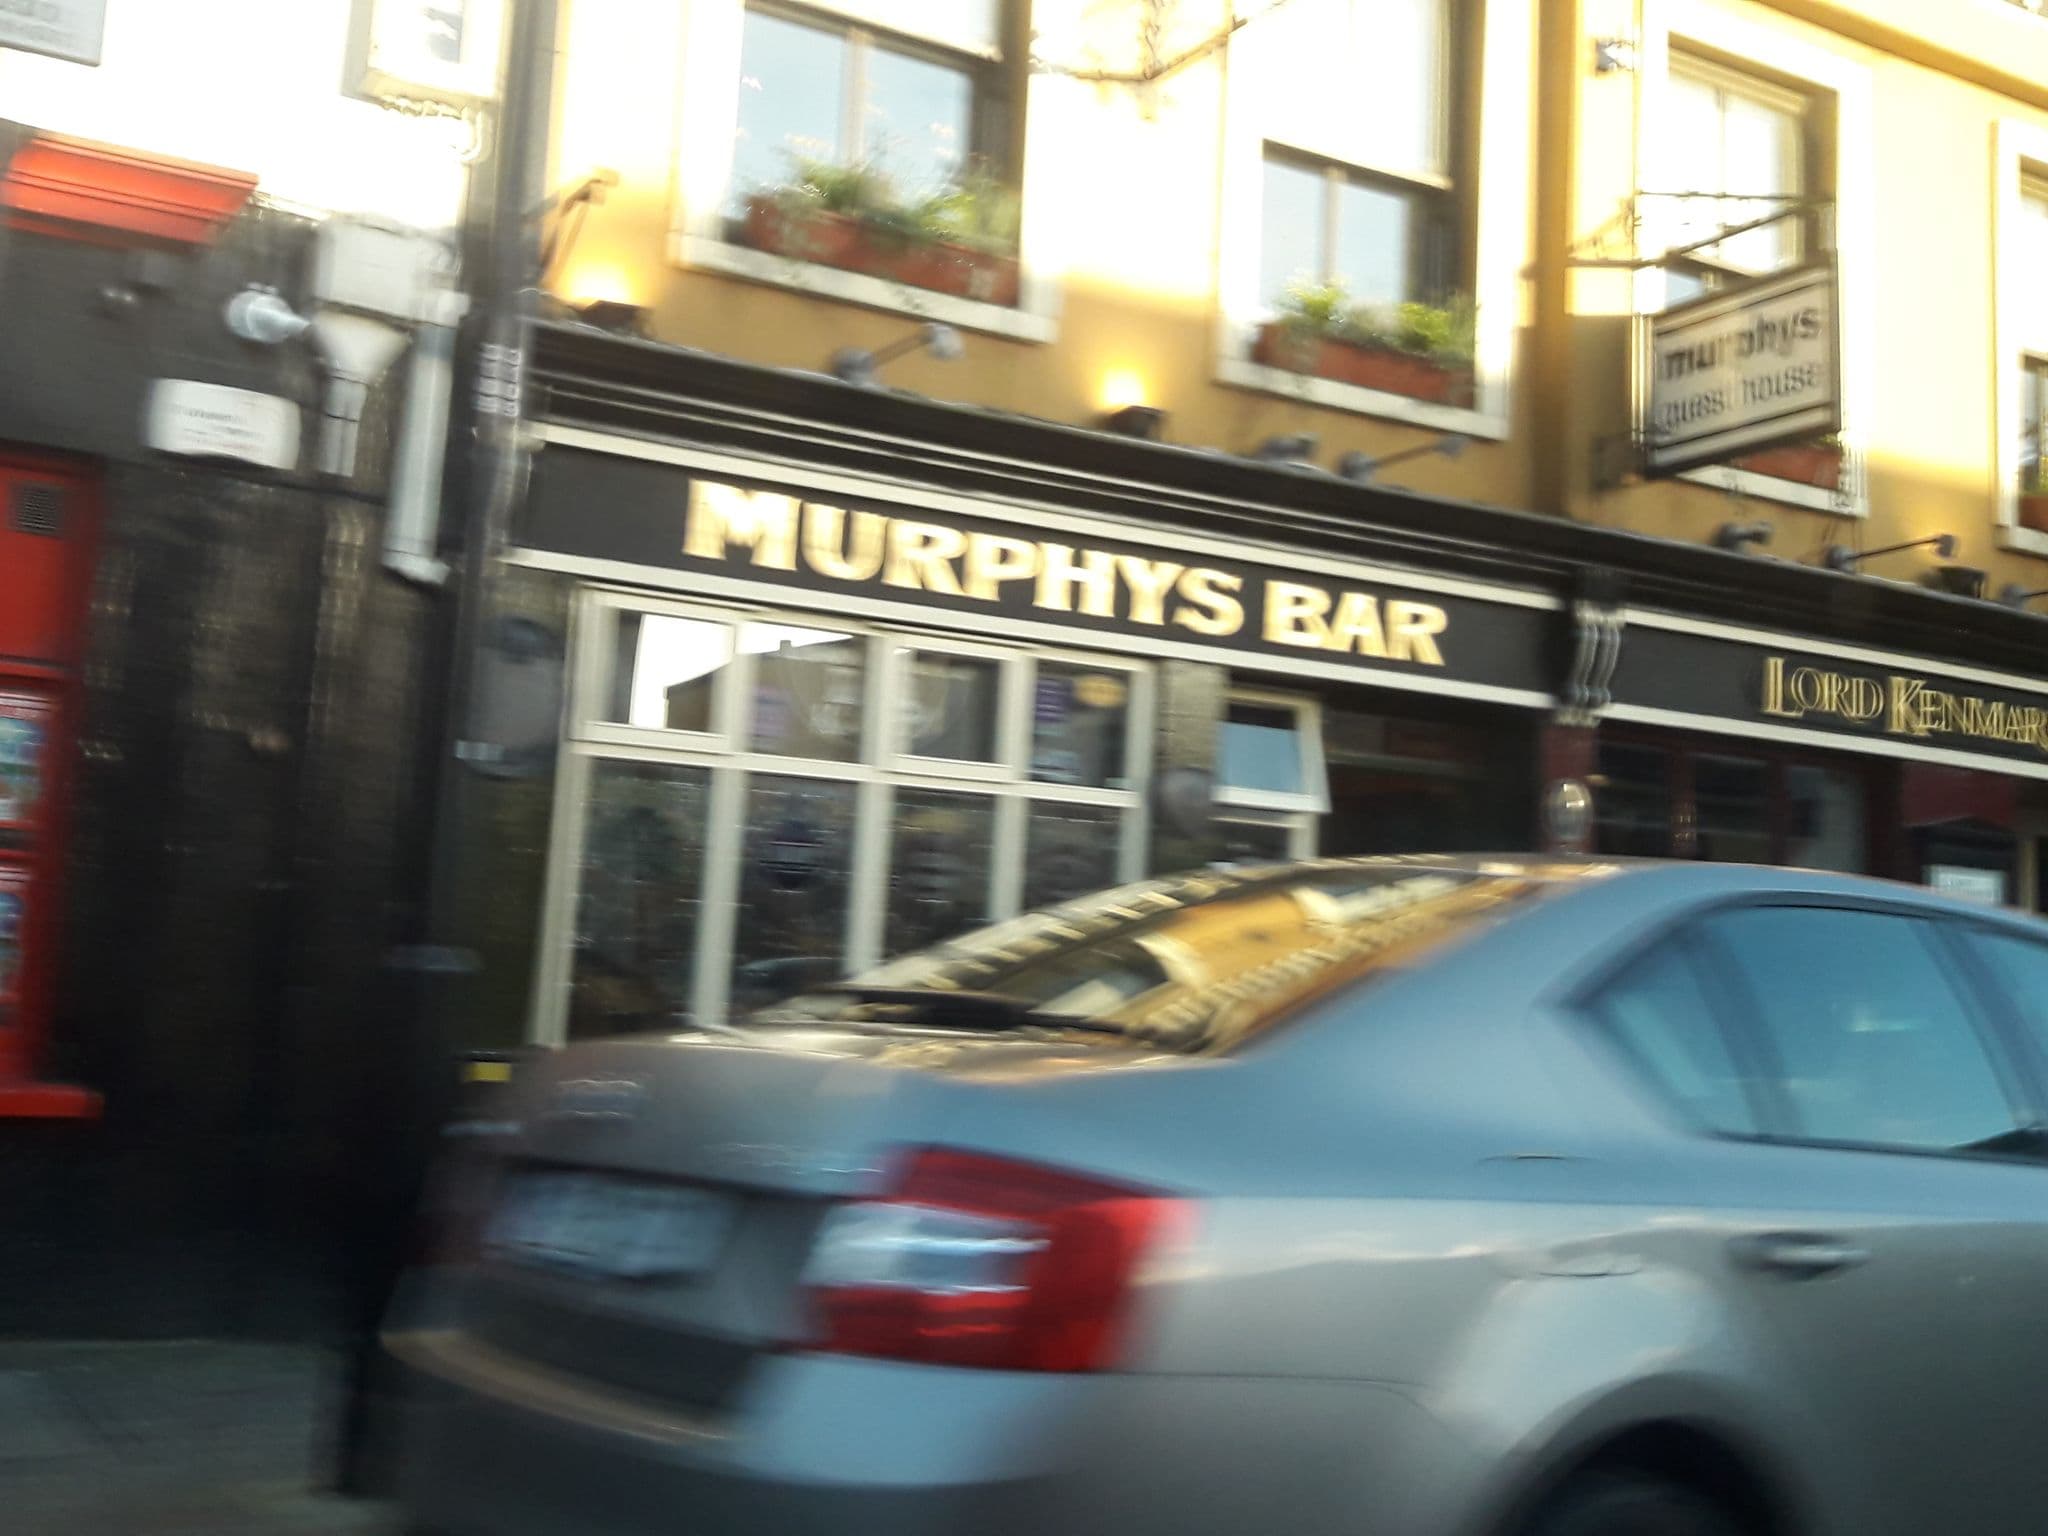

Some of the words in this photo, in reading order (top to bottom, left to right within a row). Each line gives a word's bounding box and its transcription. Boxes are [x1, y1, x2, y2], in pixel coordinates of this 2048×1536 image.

[1662, 389, 1733, 434] gues
[681, 479, 1245, 637] MURPHYS
[1261, 580, 1449, 666] BAR
[1761, 657, 1884, 724] LORD
